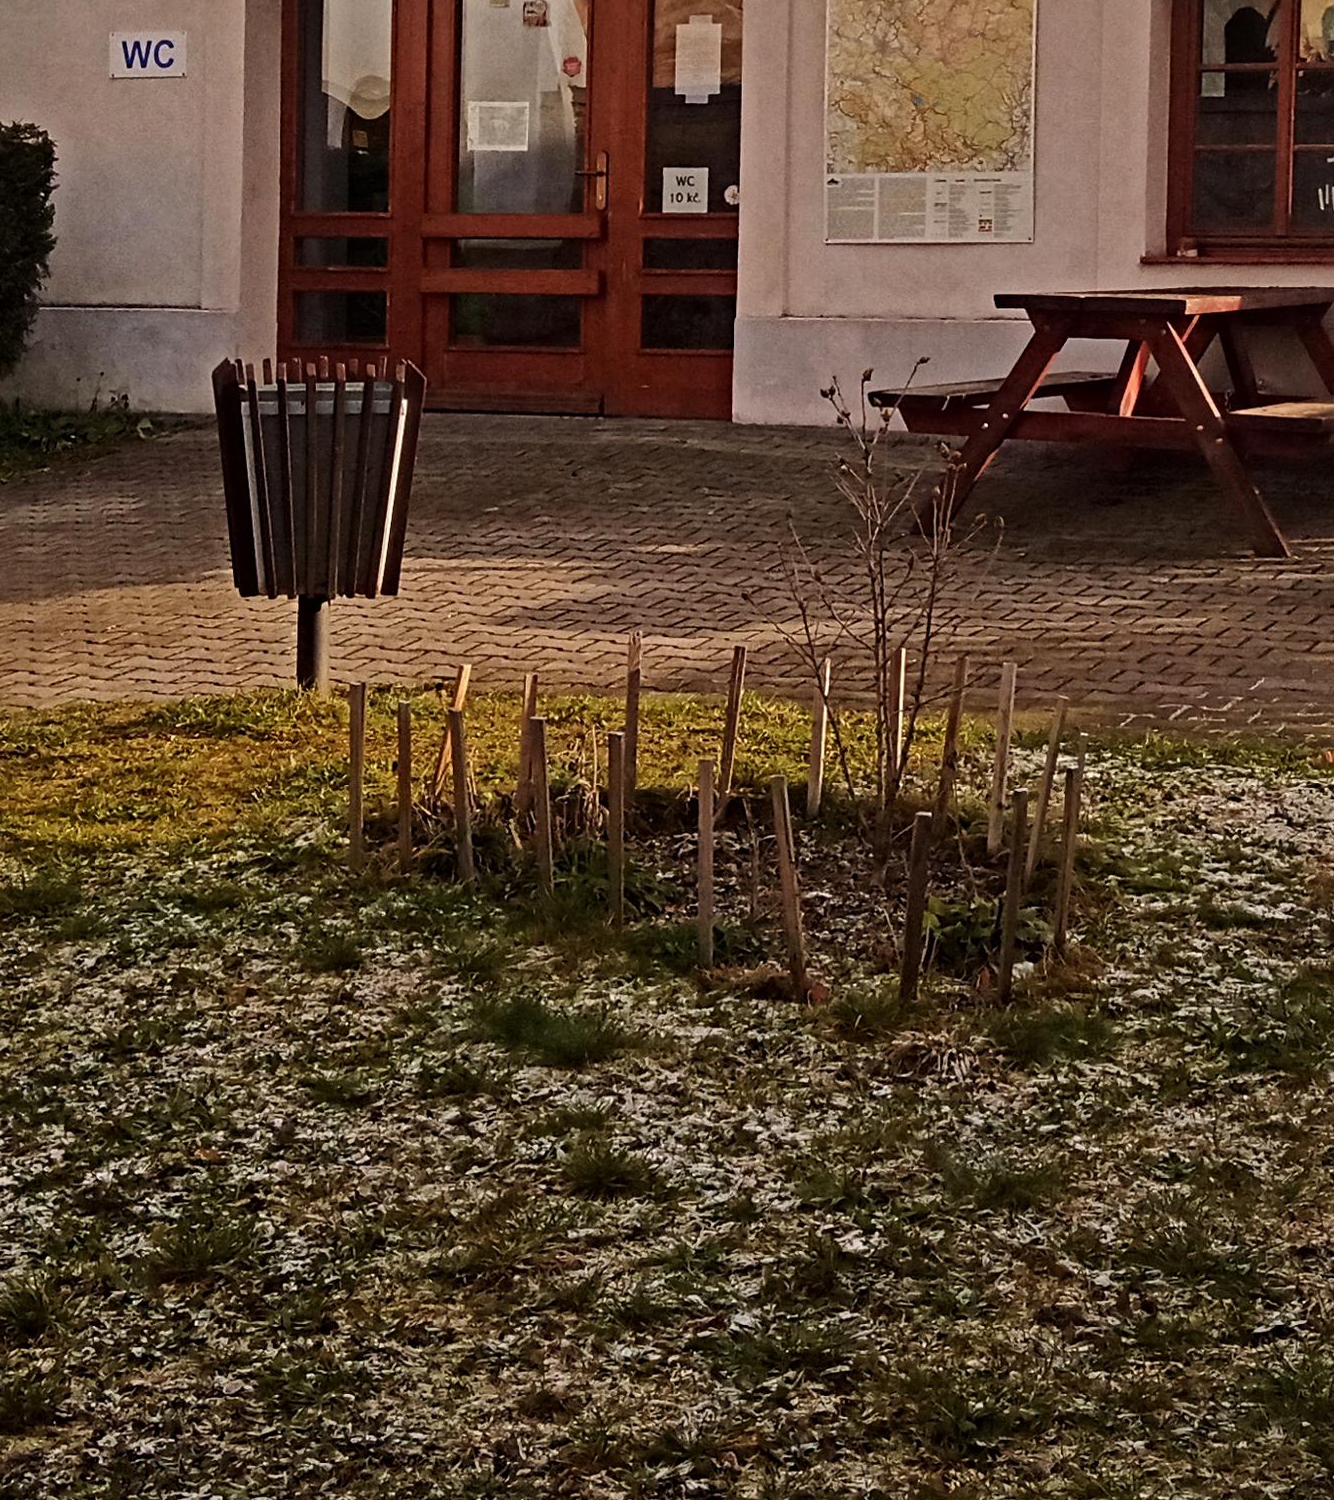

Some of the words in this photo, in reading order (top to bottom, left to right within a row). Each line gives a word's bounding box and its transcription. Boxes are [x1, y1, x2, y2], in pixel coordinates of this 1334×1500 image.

[122, 39, 175, 69] WC
[676, 175, 695, 187] WC
[670, 192, 684, 203] 10
